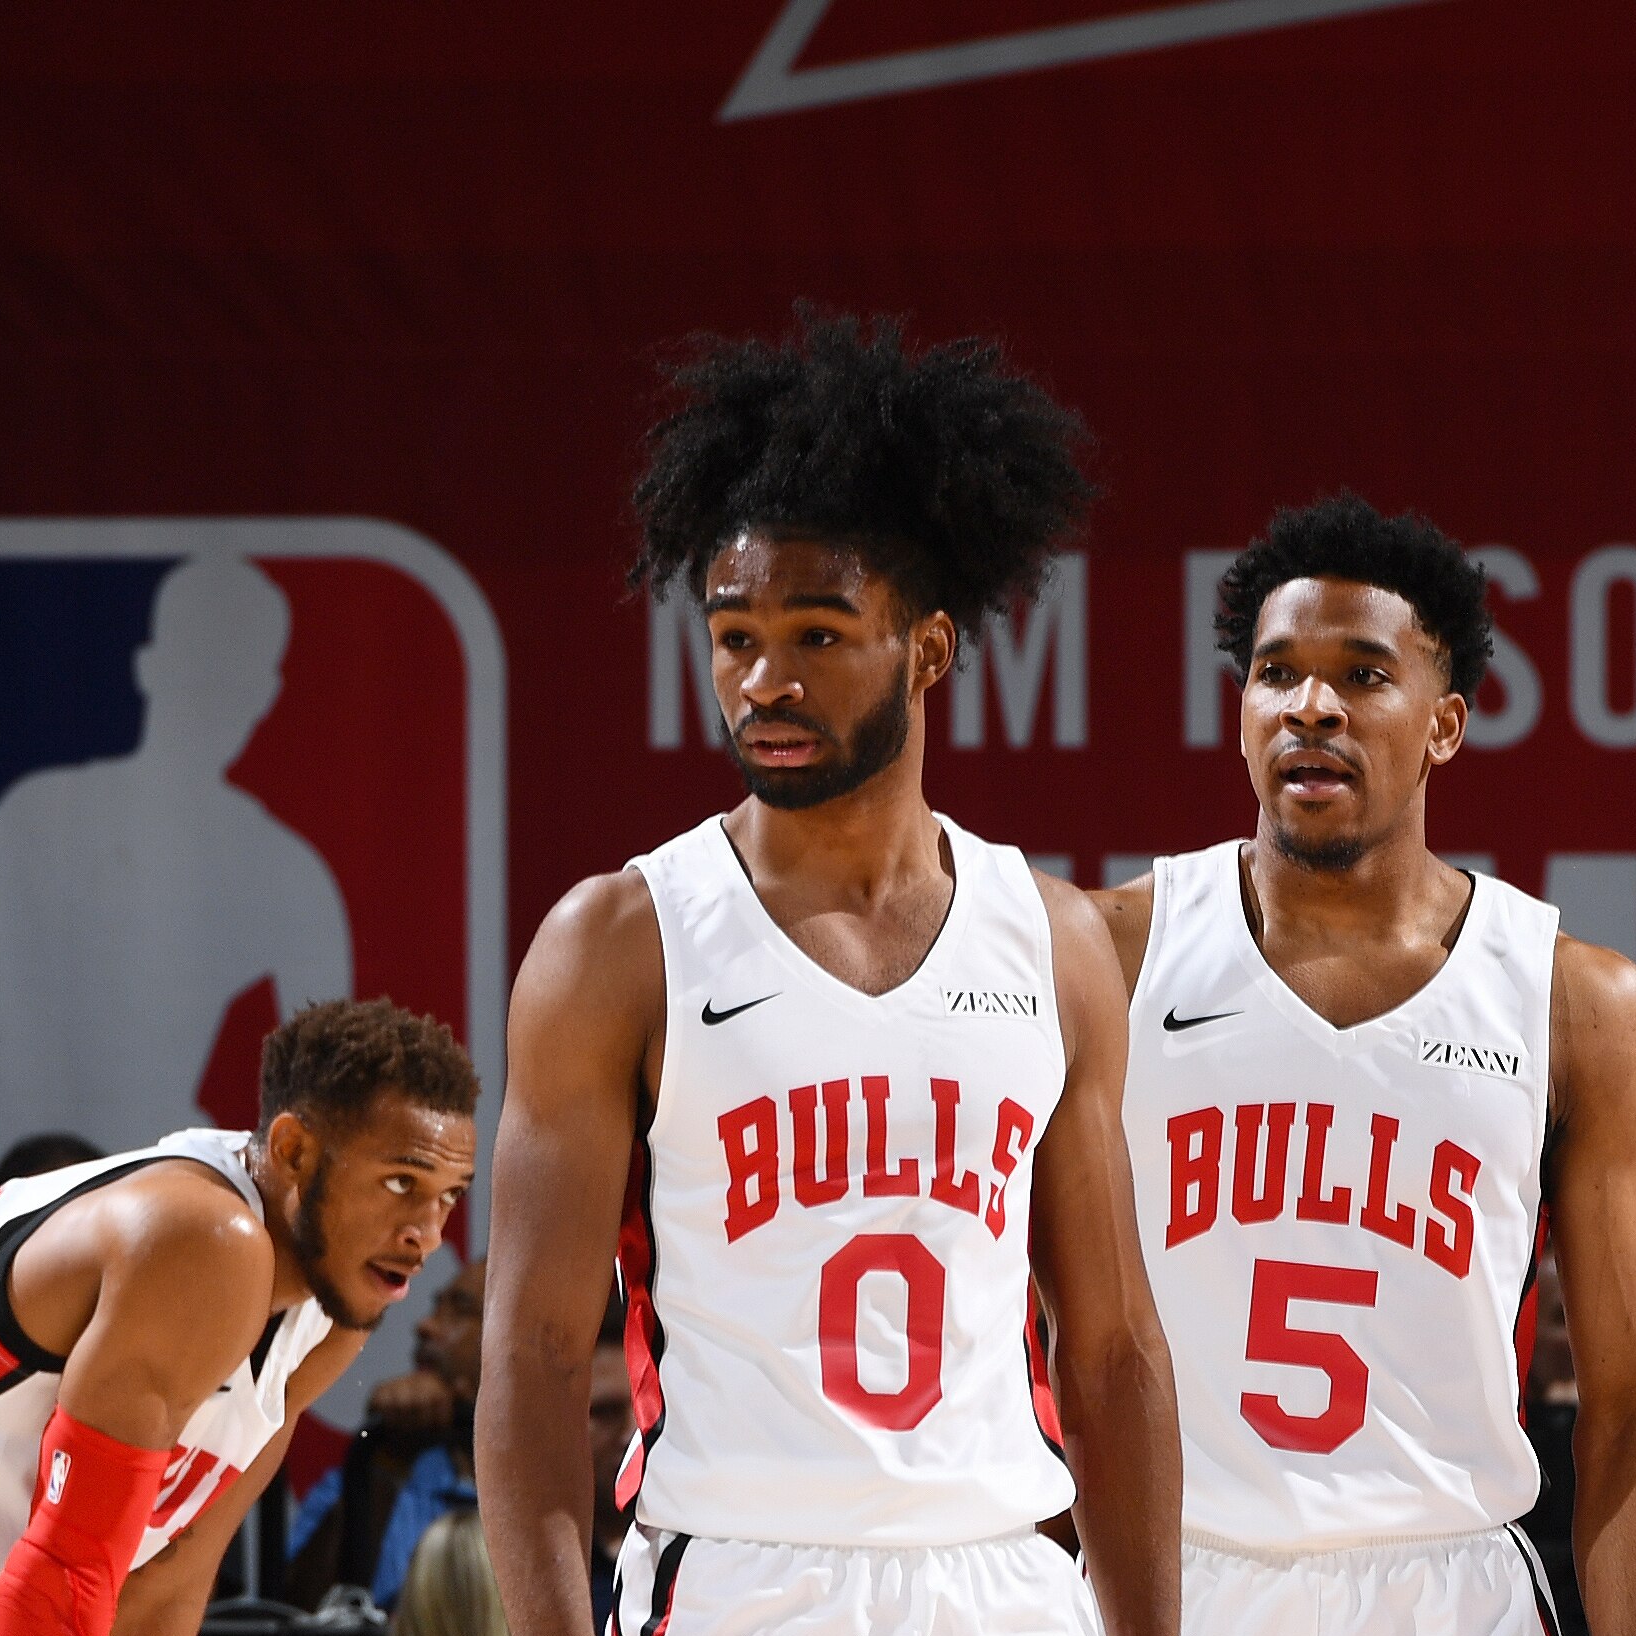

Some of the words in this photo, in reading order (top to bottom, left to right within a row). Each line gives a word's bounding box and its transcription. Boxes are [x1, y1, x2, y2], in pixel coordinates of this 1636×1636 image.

[945, 991, 1038, 1017] ZENNI
[1422, 1040, 1519, 1077] ZENNI
[716, 1075, 1035, 1243] BULLS
[1165, 1102, 1482, 1280] BULLS
[819, 1234, 946, 1432] 0
[1240, 1258, 1379, 1454] 5
